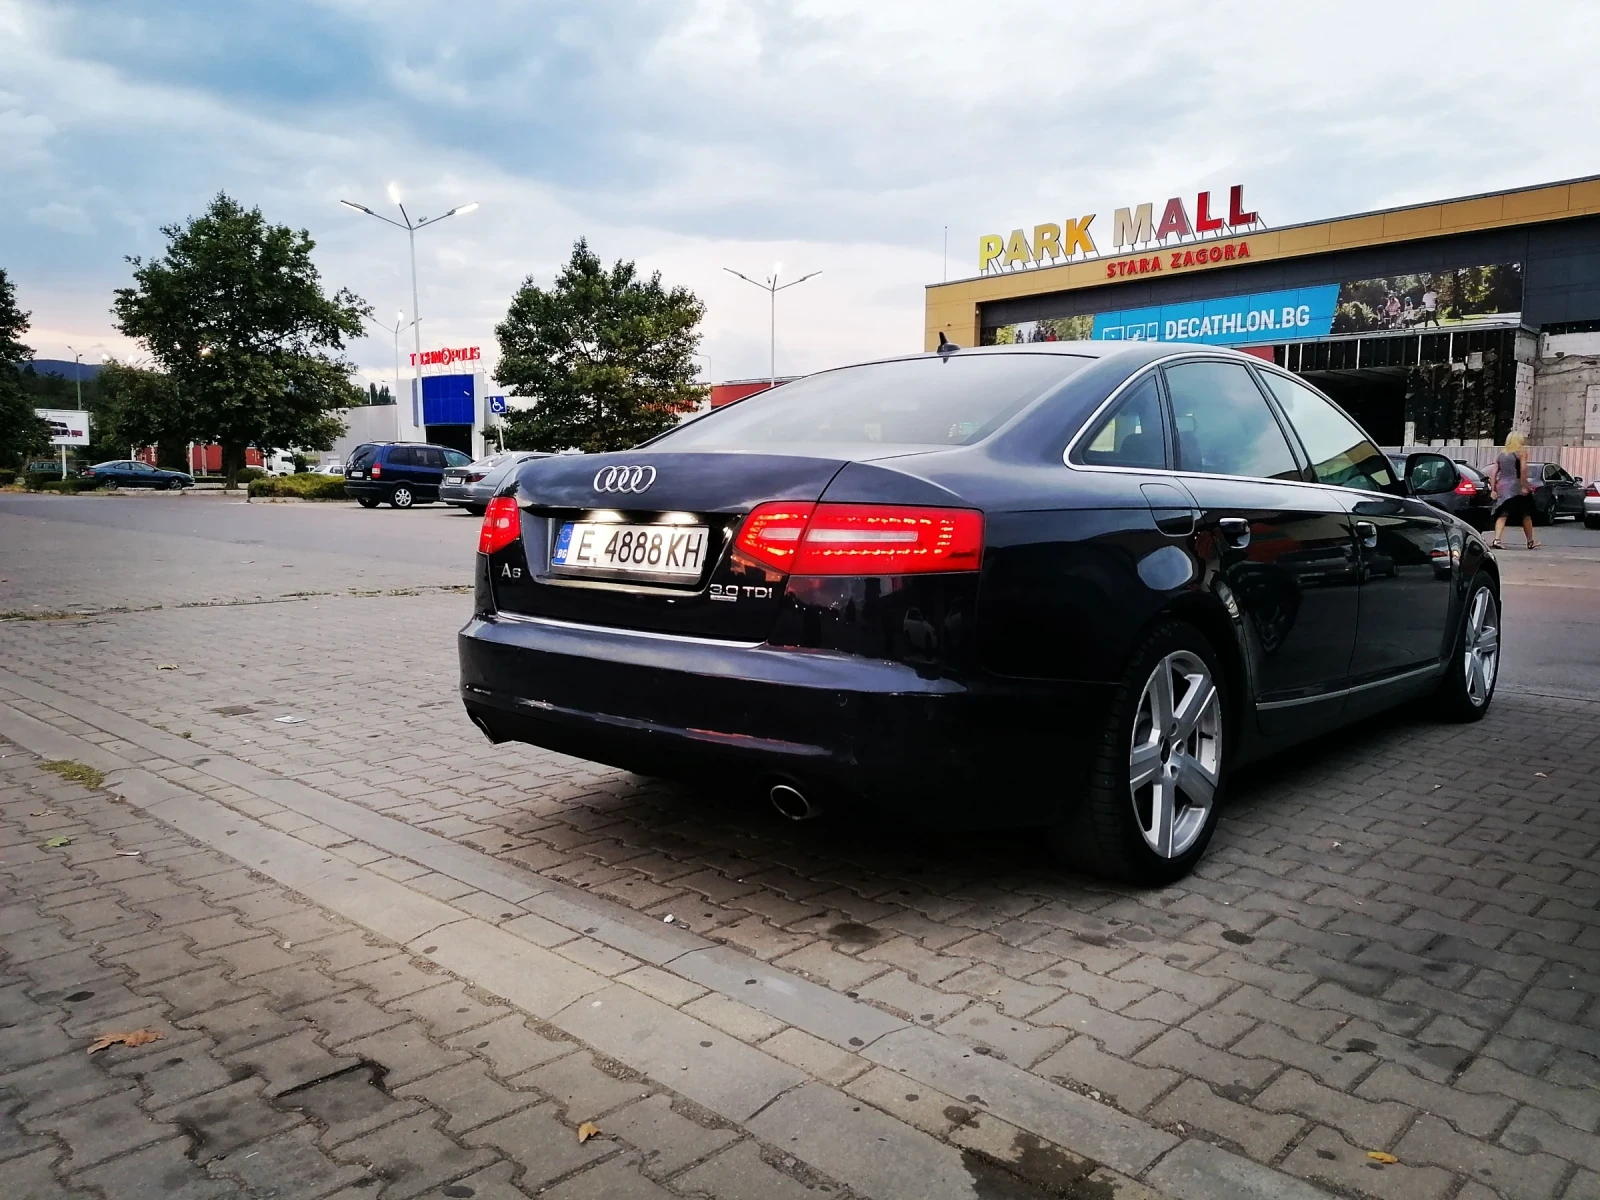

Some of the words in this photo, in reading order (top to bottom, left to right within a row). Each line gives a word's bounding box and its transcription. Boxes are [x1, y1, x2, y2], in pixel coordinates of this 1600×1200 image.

[979, 214, 1096, 270] PARK
[1113, 184, 1258, 247] MALL
[1106, 256, 1162, 278] STARA
[1170, 242, 1250, 268] ZAGORA
[1165, 305, 1310, 340] DECATHLON.BG
[410, 346, 480, 366] TCHNOPOLIS
[557, 549, 567, 559] BG
[604, 530, 663, 565] 4888
[501, 562, 521, 578] A6
[709, 583, 739, 596] 3.0
[742, 586, 773, 599] TDI
